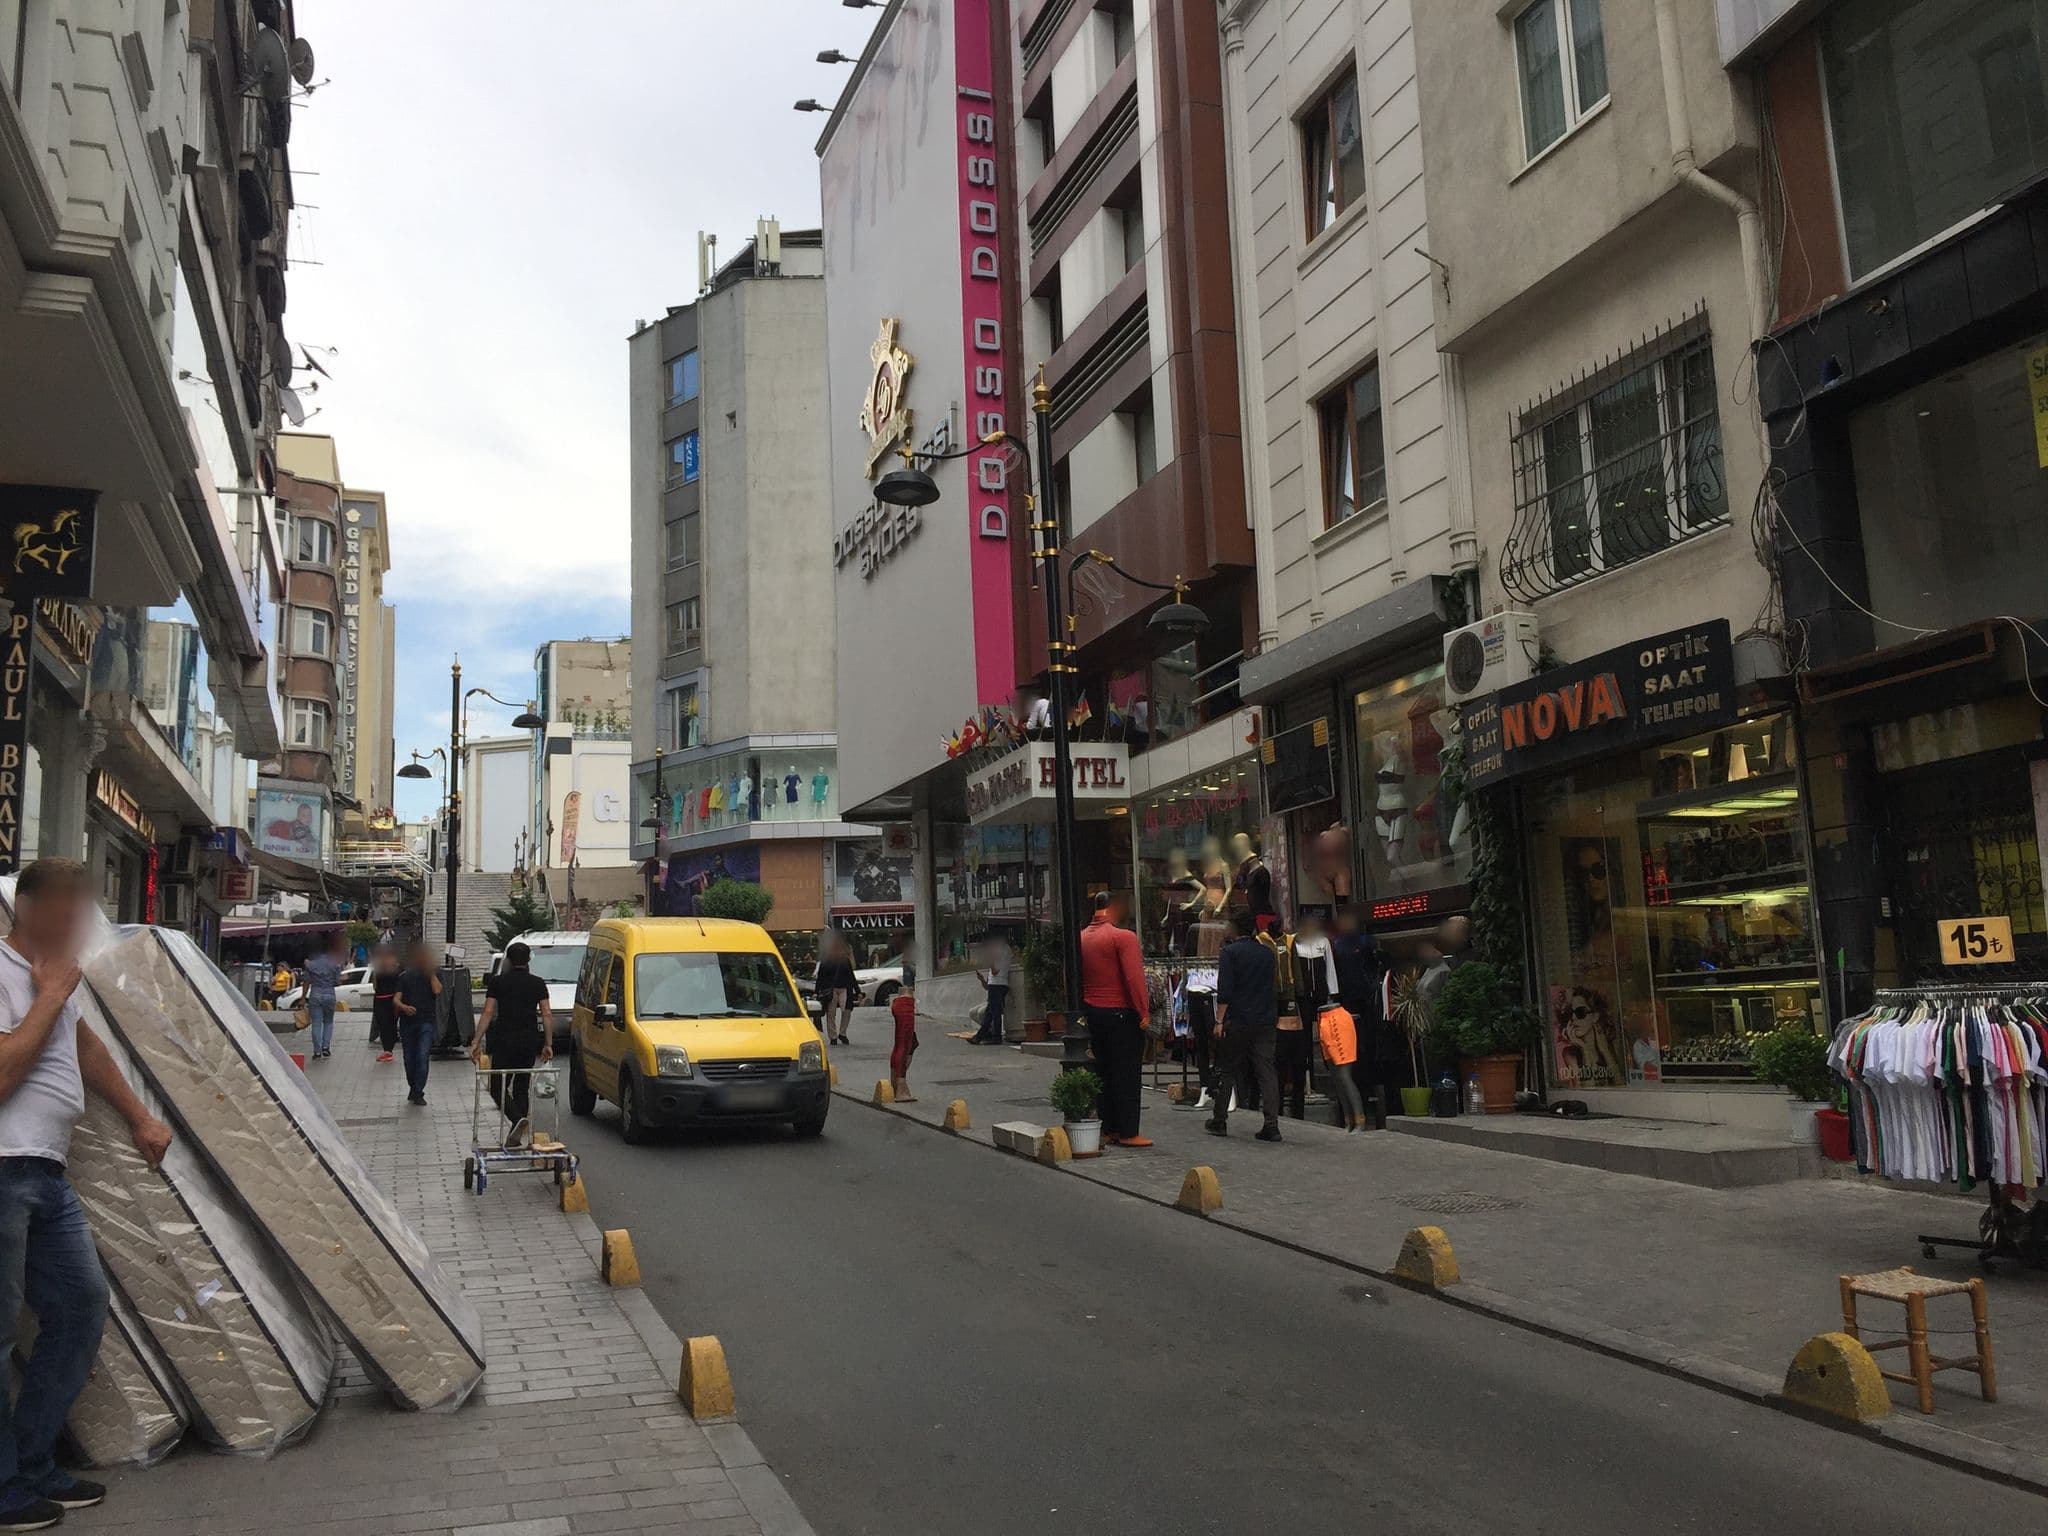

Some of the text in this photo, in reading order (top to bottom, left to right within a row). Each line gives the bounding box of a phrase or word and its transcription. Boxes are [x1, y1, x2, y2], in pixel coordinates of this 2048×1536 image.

[974, 317, 1008, 539] DOSSO
[859, 505, 920, 580] SHOES
[1494, 622, 1503, 631] LG
[4, 614, 28, 720] PAUL
[343, 527, 360, 796] GRAND MARCELLO HOTEL
[1640, 634, 1710, 667] OPTİK
[1645, 665, 1706, 695] SAAT
[1501, 672, 1627, 750] NOVA
[1642, 692, 1721, 725] TELEFON
[1472, 726, 1499, 753] SAAT
[1039, 757, 1125, 789] HTEL
[1470, 753, 1505, 780] TELEFON
[842, 914, 905, 929] KAMER
